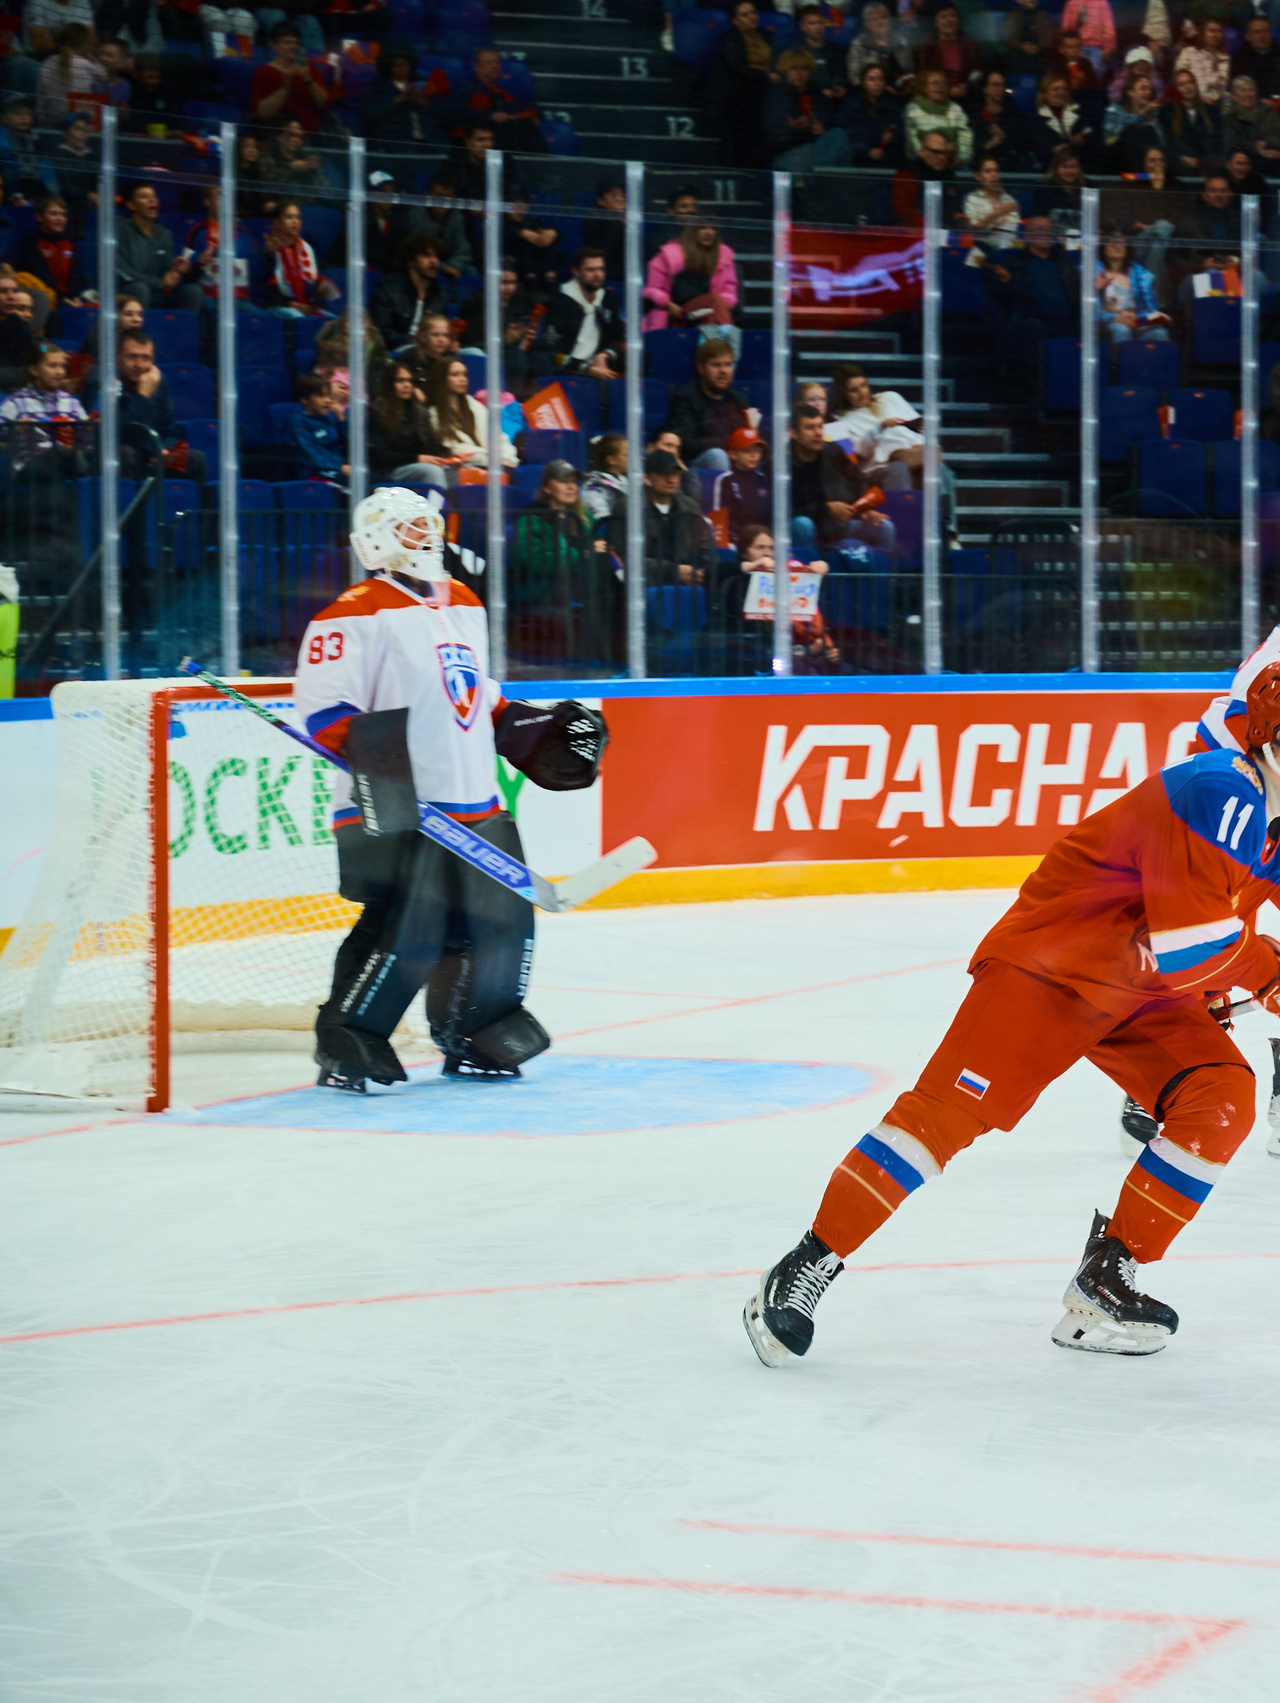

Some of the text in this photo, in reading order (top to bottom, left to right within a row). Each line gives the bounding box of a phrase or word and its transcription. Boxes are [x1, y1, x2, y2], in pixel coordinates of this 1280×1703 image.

[620, 57, 647, 78] 13
[666, 117, 694, 138] 12
[714, 180, 735, 202] 11
[308, 632, 343, 664] 83
[753, 721, 1198, 832] КРАСНА
[1217, 796, 1254, 850] 11
